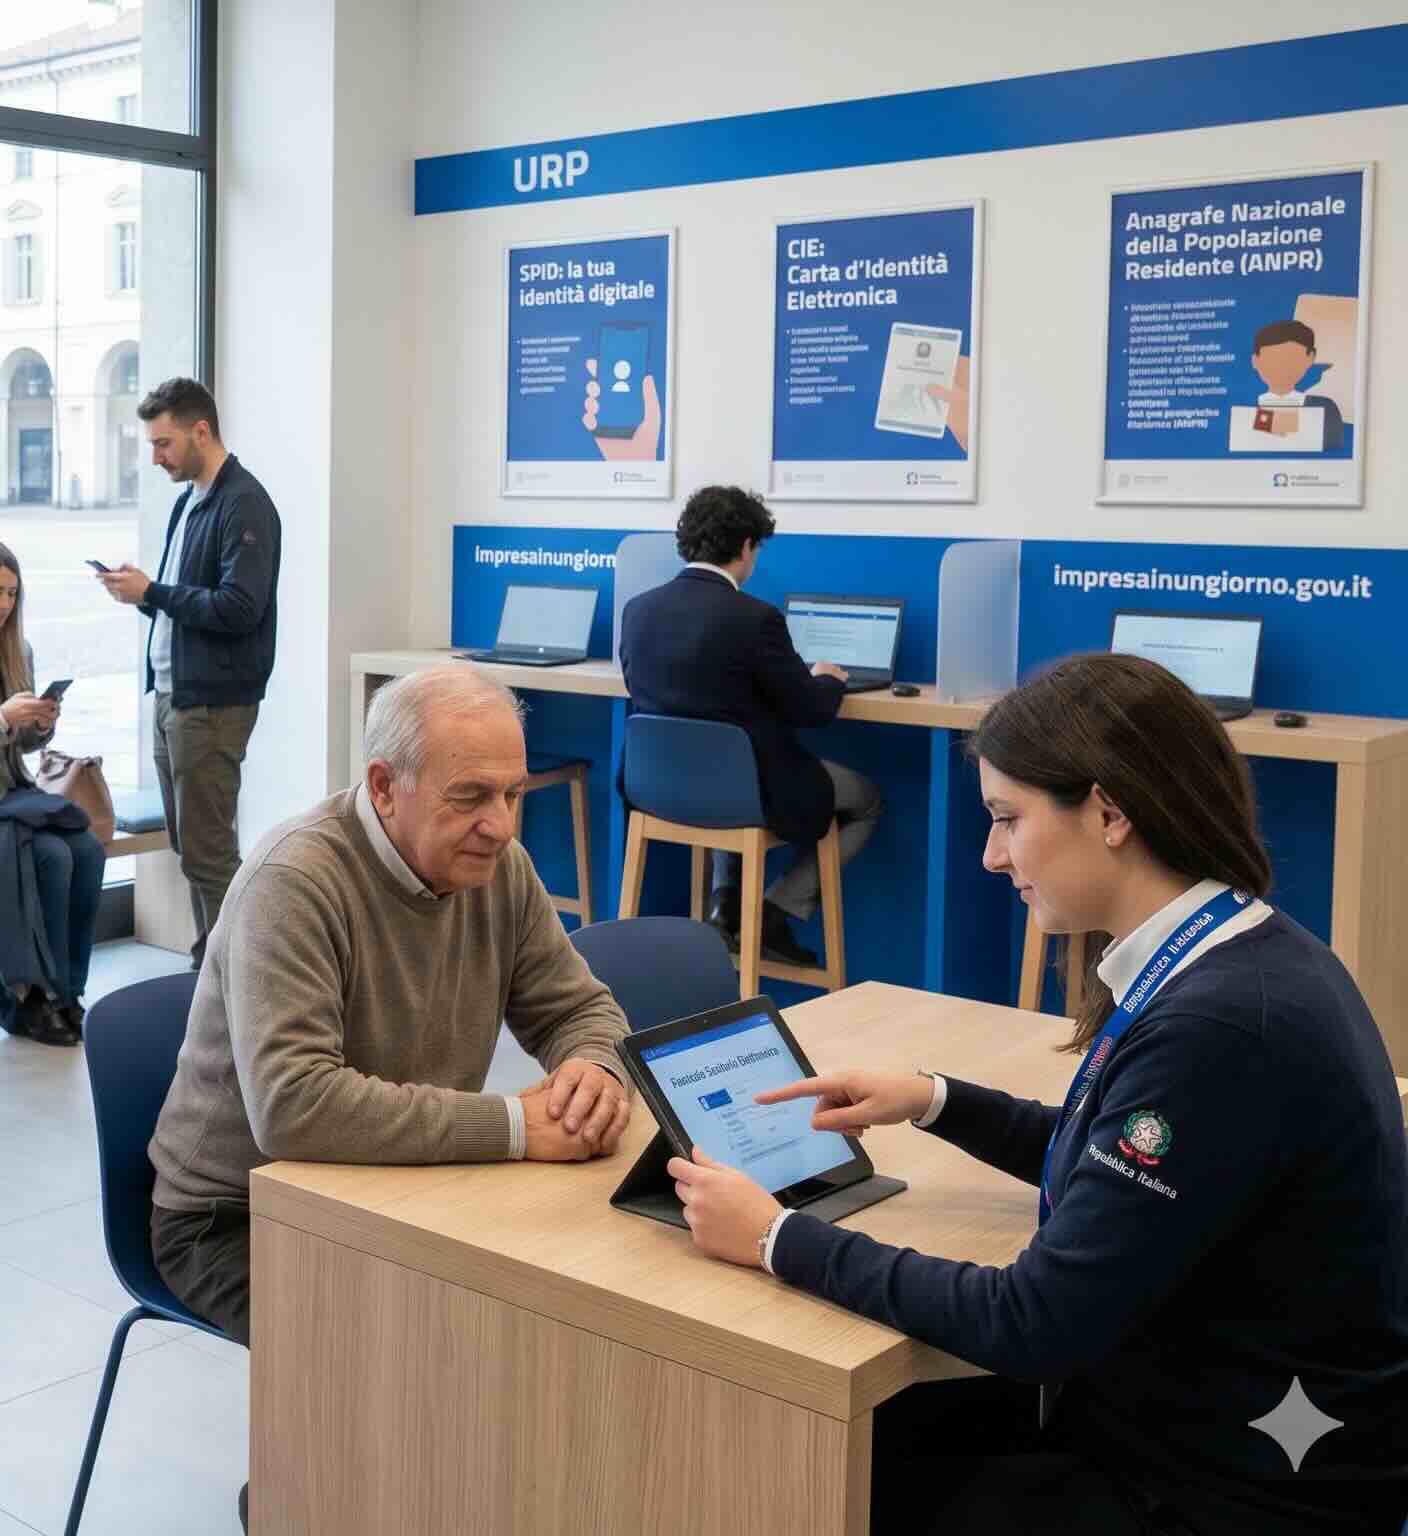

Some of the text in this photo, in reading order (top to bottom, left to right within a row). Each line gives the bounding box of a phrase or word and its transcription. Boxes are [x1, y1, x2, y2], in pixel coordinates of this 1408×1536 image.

[513, 150, 589, 193] URP
[1125, 196, 1345, 232] Anagrafe Nazionale
[787, 238, 825, 259] CIE:
[1125, 225, 1322, 256] della Popolazione
[519, 260, 615, 283] SPID: la tua
[787, 252, 949, 285] Carta d'Identità
[1125, 248, 1323, 280] Residente (ANPR)
[519, 279, 655, 307] identità digitale
[787, 286, 898, 311] Elettronica
[475, 544, 616, 573] impresainungiorn
[1053, 564, 1372, 602] impresainungiorno.gov.it
[1138, 1169, 1178, 1200] Italiana
